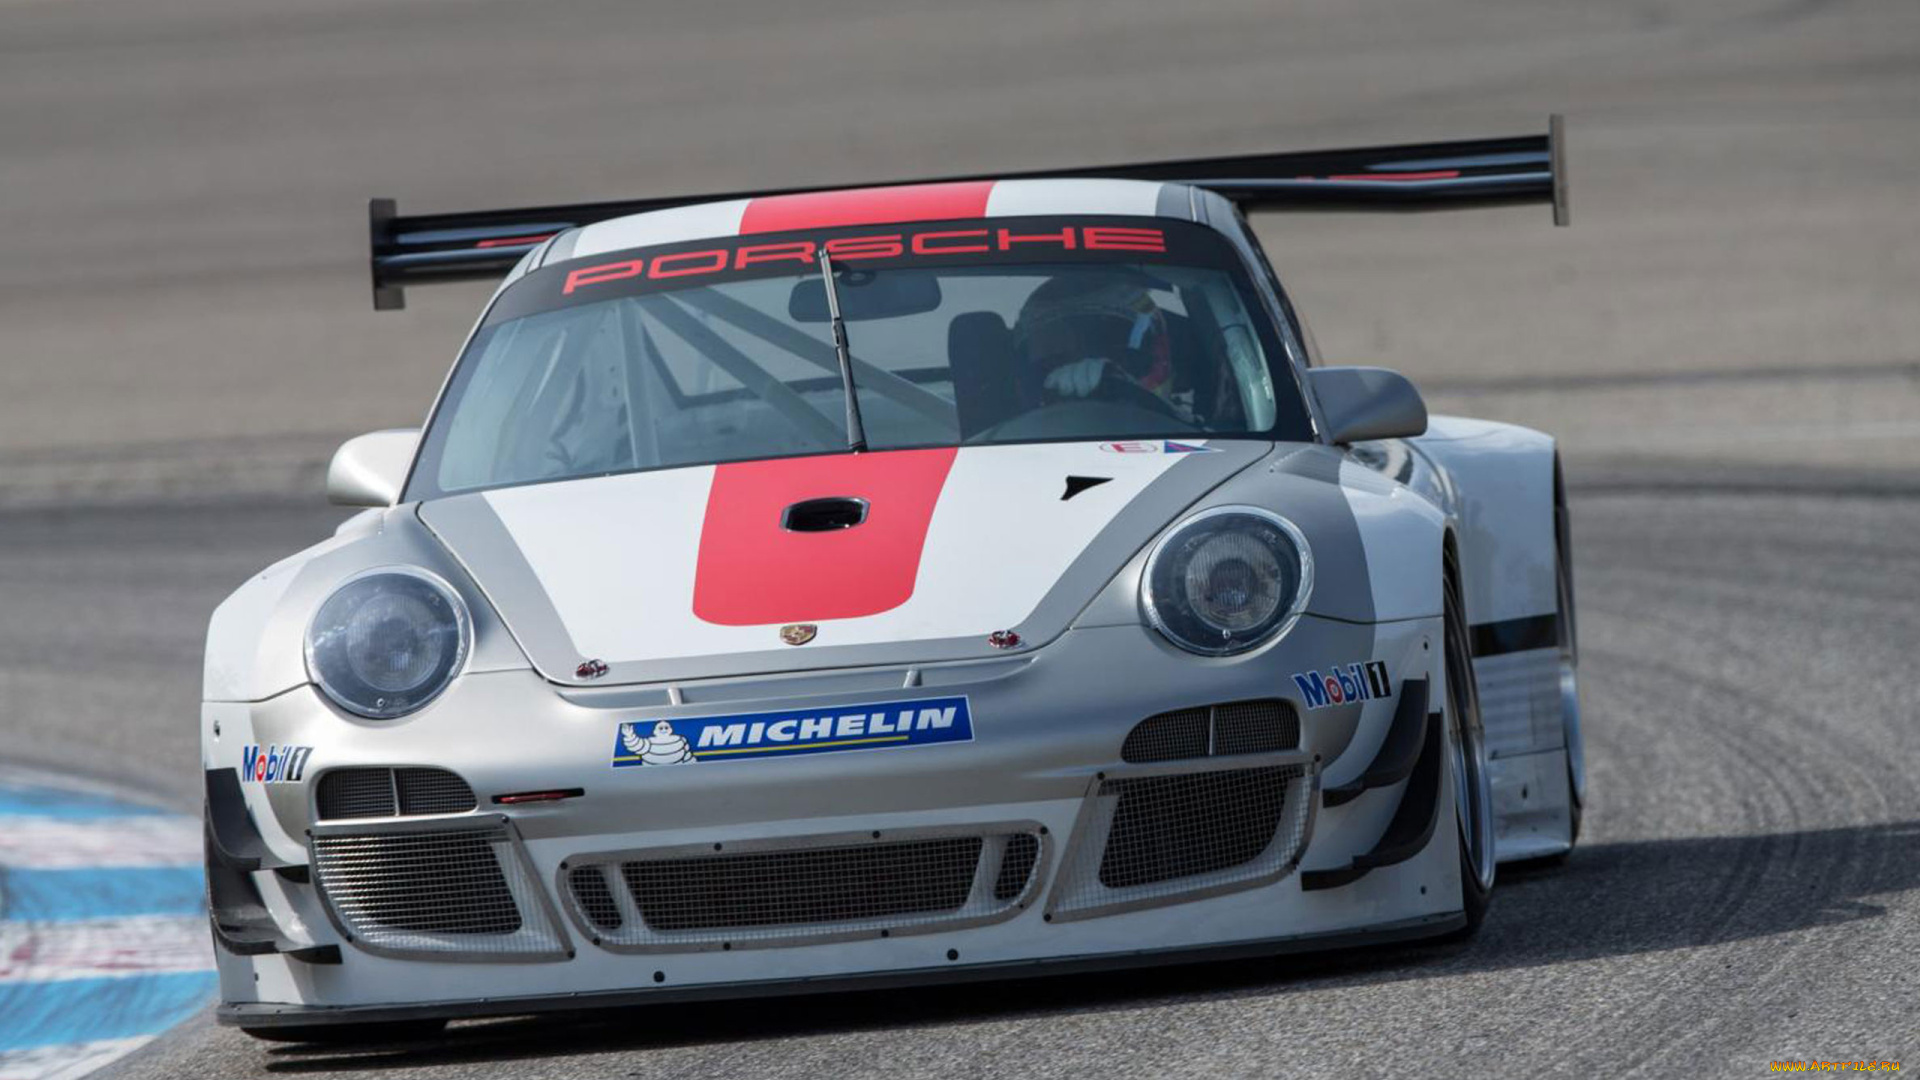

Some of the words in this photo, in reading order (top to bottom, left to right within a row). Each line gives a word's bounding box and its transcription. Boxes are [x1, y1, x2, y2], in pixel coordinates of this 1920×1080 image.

[562, 227, 1165, 295] PORSCHE
[1292, 663, 1370, 708] Mobil
[697, 707, 956, 748] MICHELIN
[242, 745, 293, 782] Mobil
